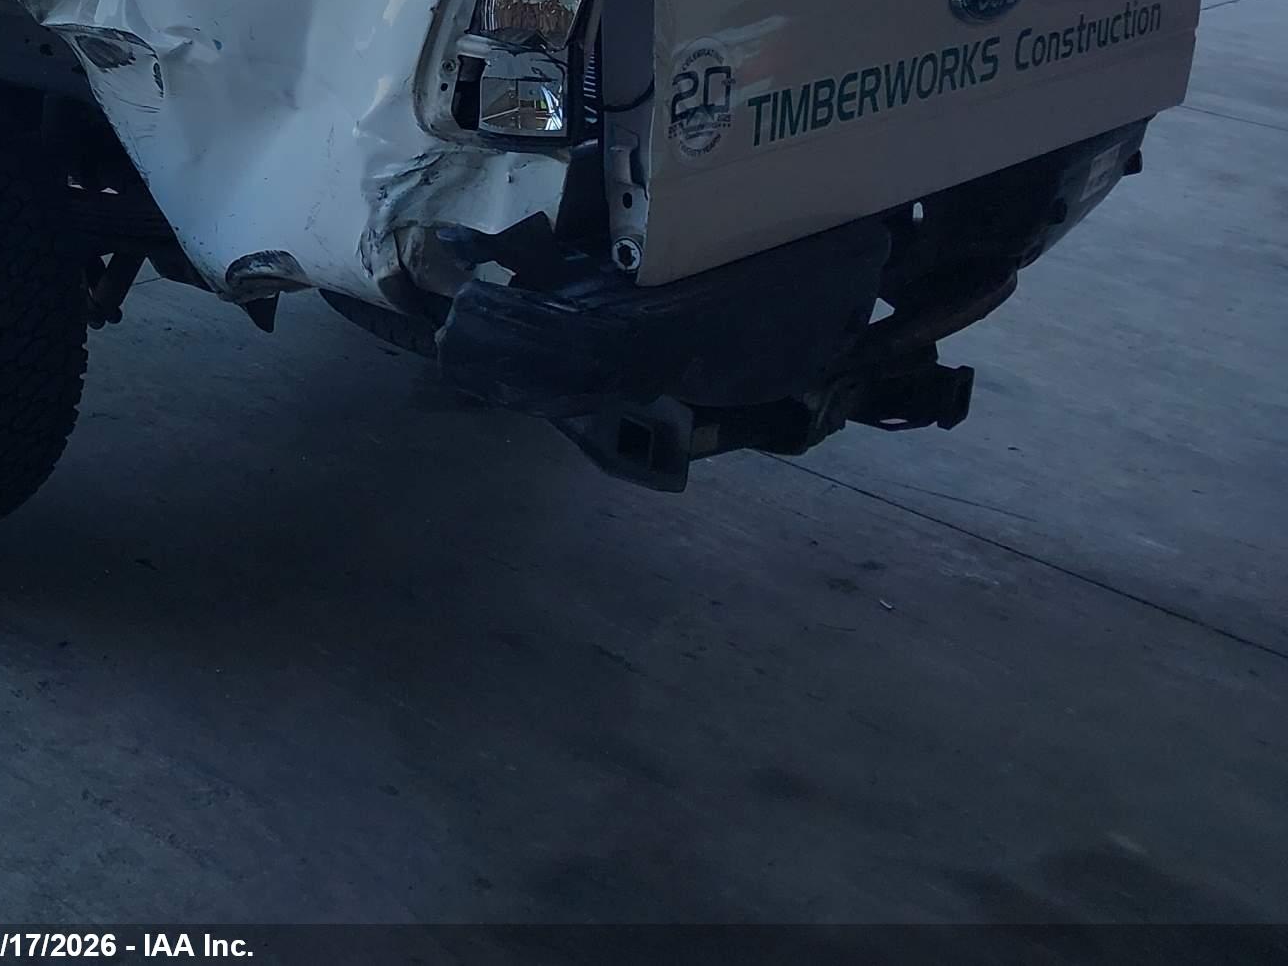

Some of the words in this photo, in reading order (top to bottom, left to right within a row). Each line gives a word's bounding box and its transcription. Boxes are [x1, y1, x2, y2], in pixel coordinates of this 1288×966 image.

[670, 65, 732, 123] 20
[747, 36, 1001, 147] TIMBERWORKS
[1014, 0, 1161, 71] Construction
